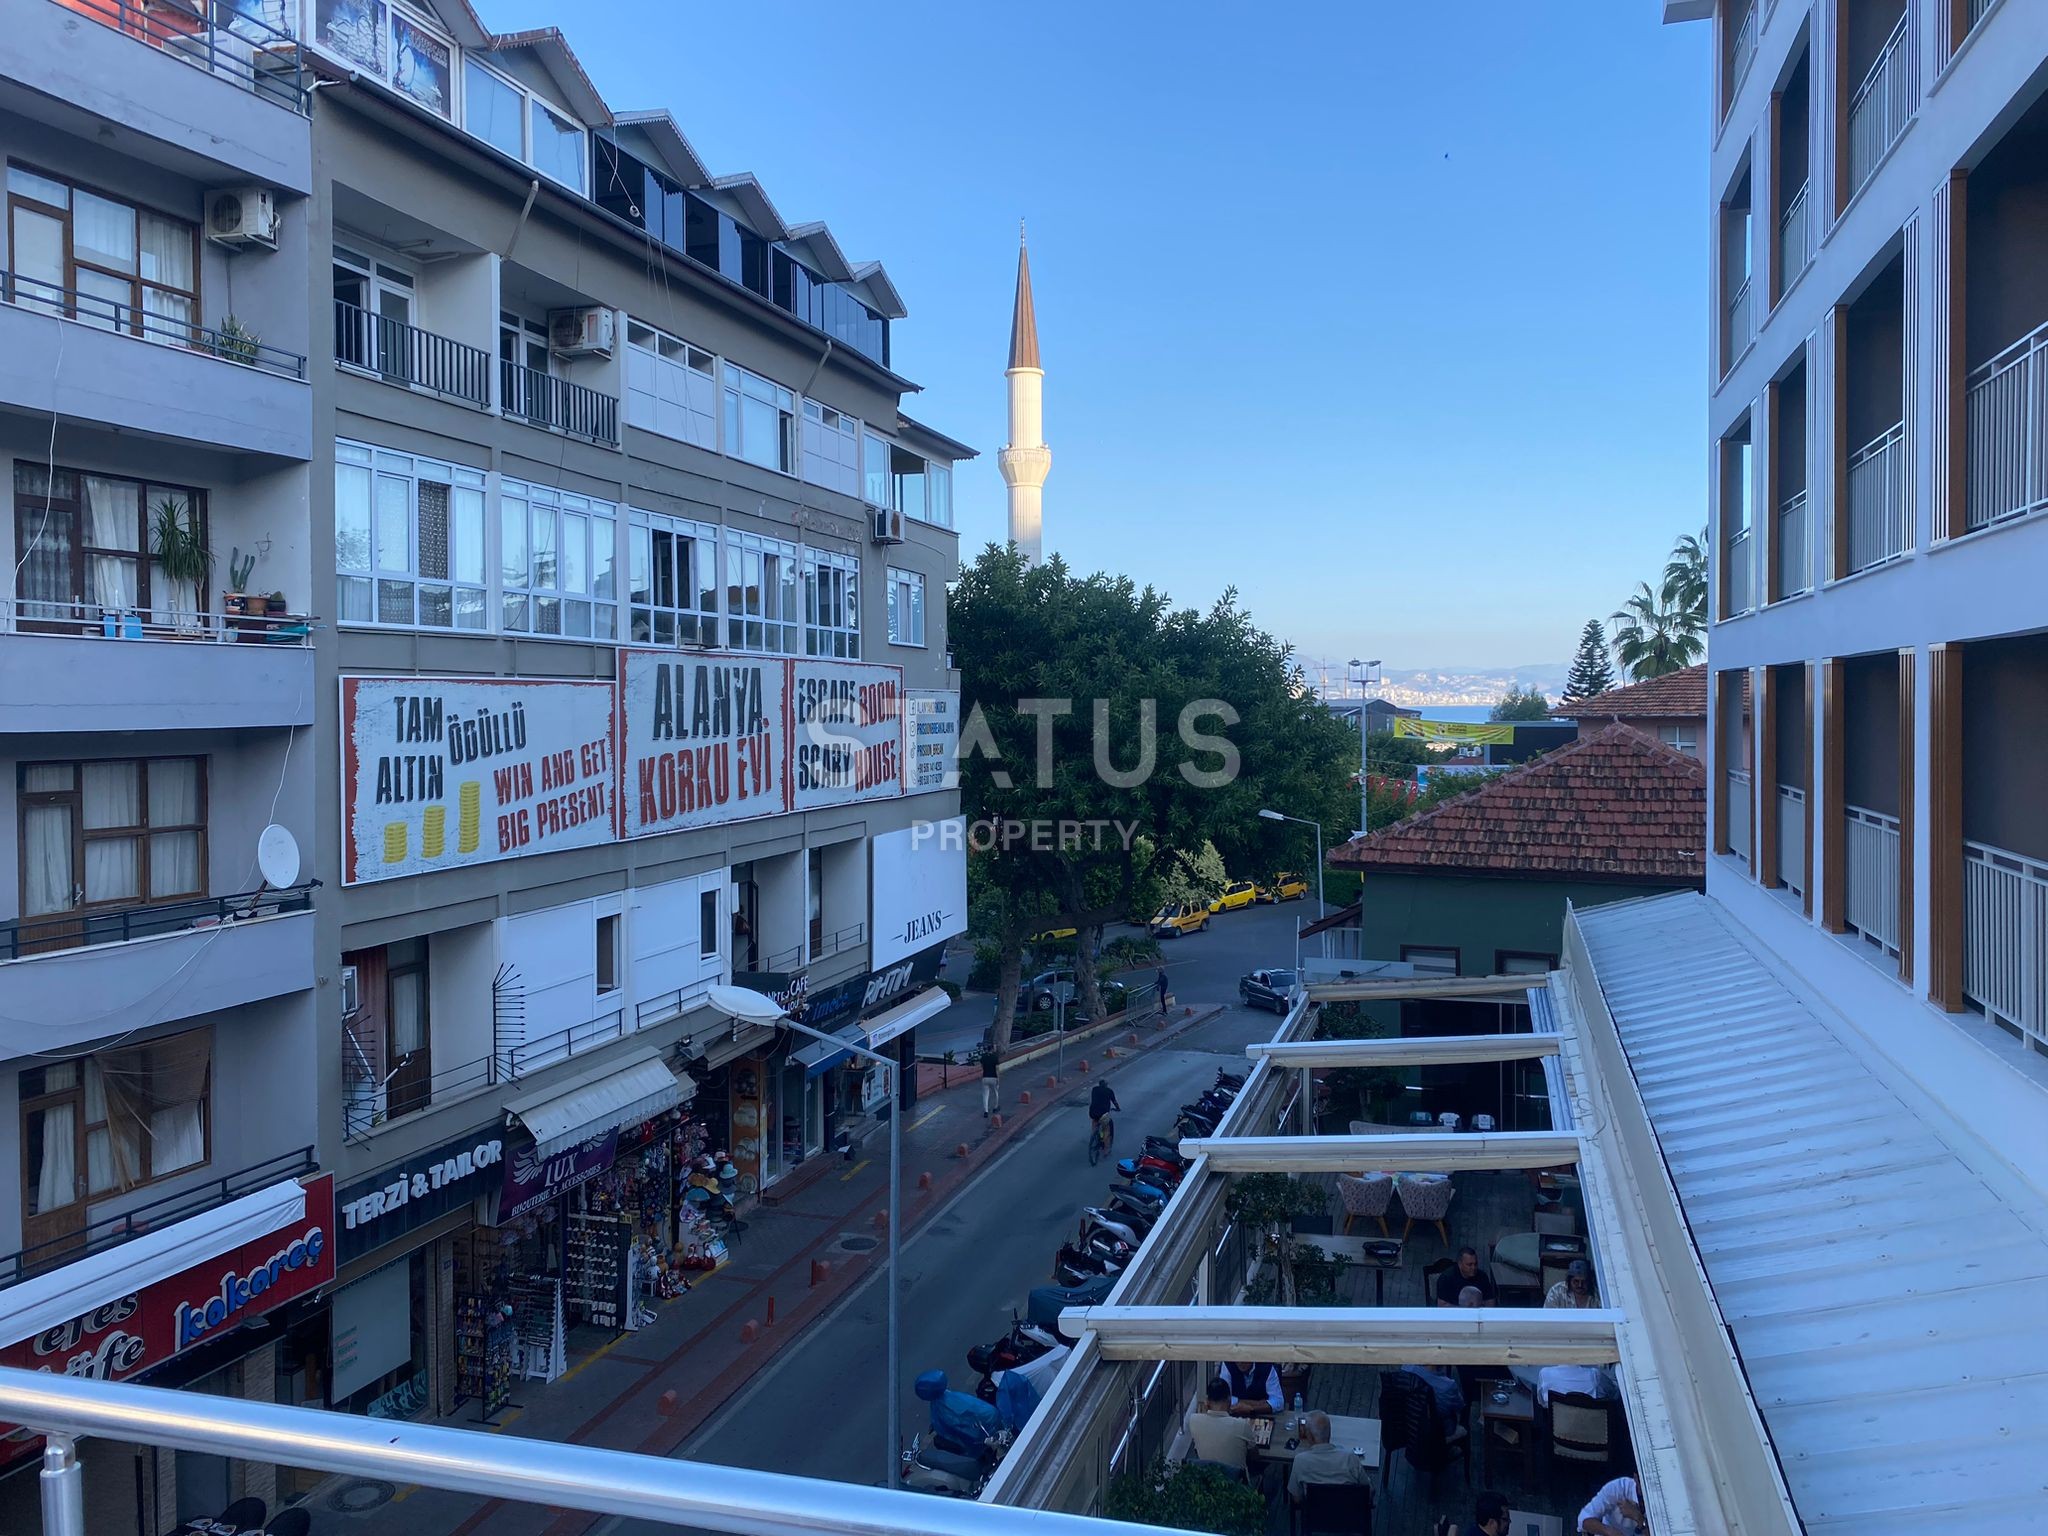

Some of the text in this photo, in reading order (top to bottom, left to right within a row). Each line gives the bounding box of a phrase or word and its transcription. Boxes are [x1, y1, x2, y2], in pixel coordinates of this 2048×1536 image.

[394, 696, 443, 743] TAM
[652, 663, 763, 740] ALANYA
[798, 678, 896, 728] ESCAPE ROOM
[447, 701, 527, 765] ÖDÜLLÜ
[375, 755, 444, 804] ALTIN
[494, 738, 607, 806] WIN AND GET
[638, 742, 730, 826] KORKU
[799, 739, 897, 793] SCARY HOUSE
[497, 782, 606, 854] BIG PRESENT
[904, 910, 942, 944] JEANS
[790, 975, 809, 996] CAFE
[343, 1140, 502, 1230] TERZİ & TAILOR
[545, 1152, 579, 1187] LUX
[174, 1226, 325, 1352] kokoreç
